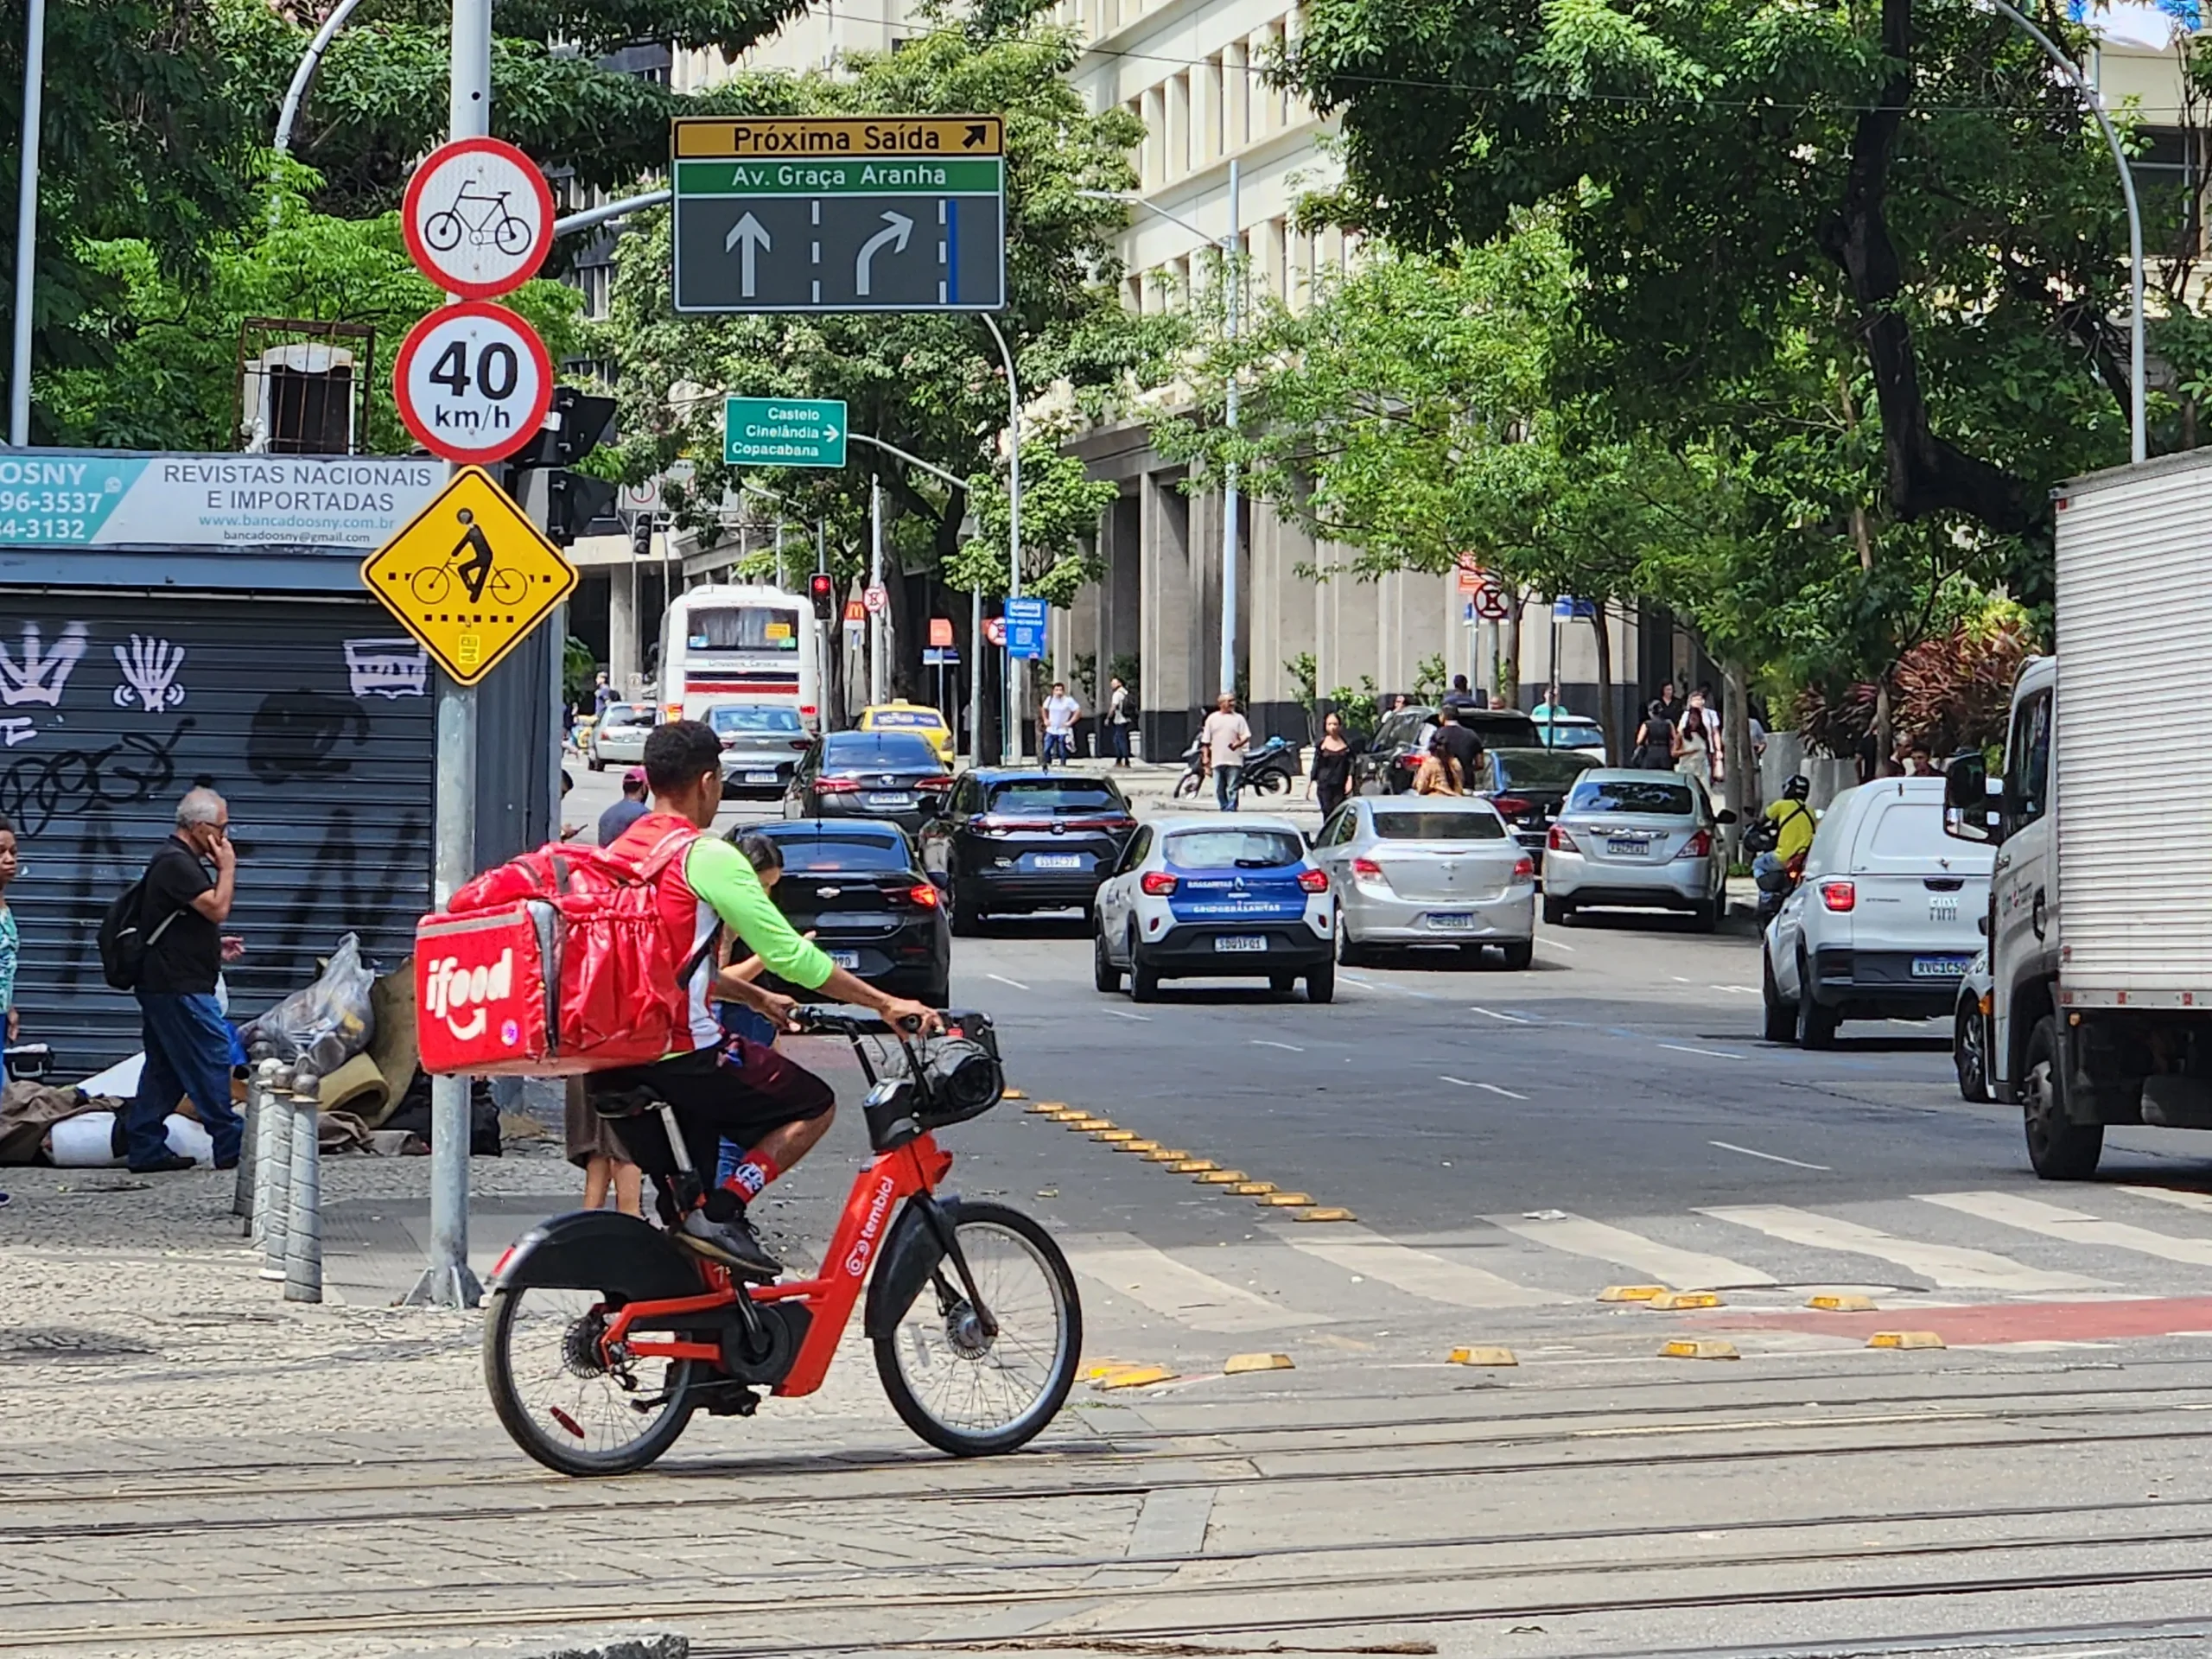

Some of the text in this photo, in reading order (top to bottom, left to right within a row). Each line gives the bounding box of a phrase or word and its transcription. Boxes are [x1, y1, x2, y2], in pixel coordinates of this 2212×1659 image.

[734, 124, 939, 152] Próxima Saída
[732, 164, 947, 189] Av. Graça Aranha
[429, 340, 518, 401] 40
[435, 404, 510, 431] km/h
[767, 407, 820, 421] Castelo
[746, 424, 819, 439] Cinelândia
[732, 442, 819, 456] Copacabana
[0, 461, 87, 486] OSNY
[163, 465, 431, 486] REVISTAS NACIONAIS
[207, 491, 394, 512] E IMPORTADAS
[0, 518, 85, 538] 4-3132
[199, 514, 395, 530] www.bancadoosny.com.br
[224, 530, 370, 543] bancadoosny@gmail.com
